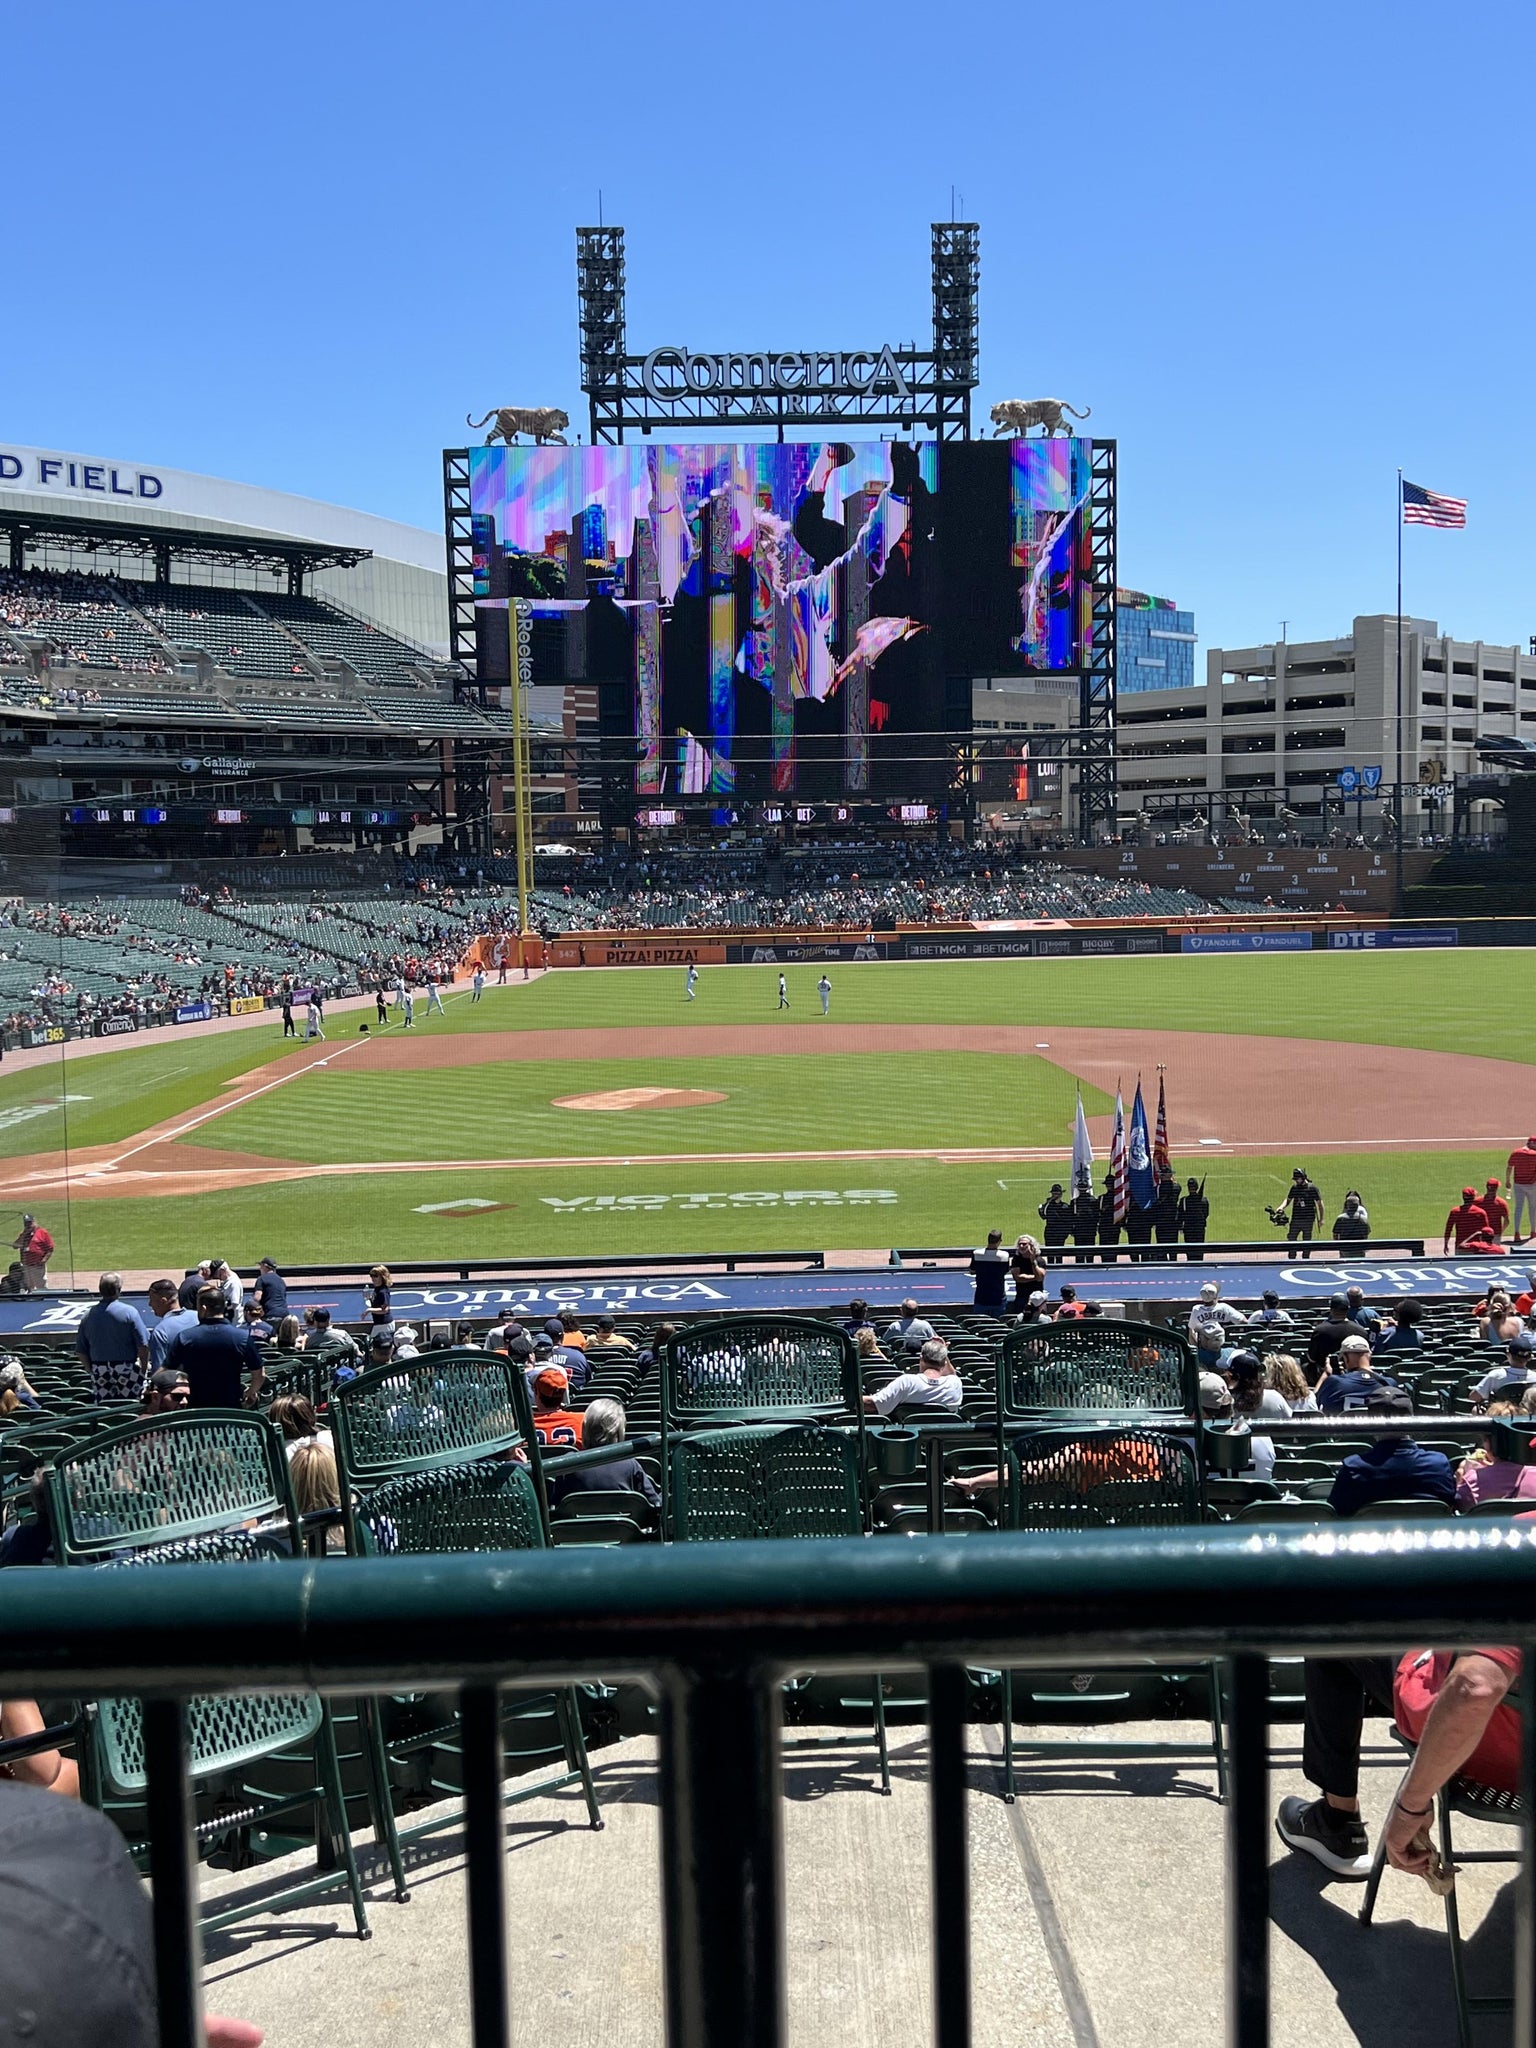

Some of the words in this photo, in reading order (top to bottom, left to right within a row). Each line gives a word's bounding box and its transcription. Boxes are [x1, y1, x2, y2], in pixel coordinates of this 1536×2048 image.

[717, 394, 842, 415] PARK
[38, 457, 163, 499] FIELD
[517, 618, 534, 689] Rocket
[202, 757, 257, 769] Gallagher
[97, 810, 110, 821] LAA
[123, 810, 136, 821] DET
[318, 812, 330, 823] LAA
[340, 812, 351, 823] DET
[648, 810, 676, 824] DETROIT
[768, 808, 782, 821] LAA
[797, 808, 811, 821] DET
[1122, 852, 1134, 862] 23
[1217, 850, 1224, 860] 5
[1267, 852, 1274, 862] 2
[1317, 853, 1328, 863] 16
[1374, 855, 1381, 865] 6
[1239, 873, 1251, 883] 47
[1292, 874, 1299, 885] 3
[1351, 875, 1356, 886] 1
[1082, 940, 1115, 948] BIGGBY
[1203, 938, 1242, 947] FANDUEL
[1264, 937, 1303, 946] FANDUEL
[1334, 932, 1376, 948] DTE
[920, 945, 967, 955] BETMGM
[982, 943, 1029, 954] BETMGM
[606, 950, 650, 963] PIZZA!
[654, 949, 698, 962] PIZZA!
[31, 1027, 66, 1046] bet365
[538, 1190, 898, 1207] VICTORS
[553, 1203, 663, 1213] HOME
[678, 1199, 898, 1209] SOLUTIONS
[461, 1300, 630, 1314] PARK
[1197, 1311, 1226, 1322] CABRERA
